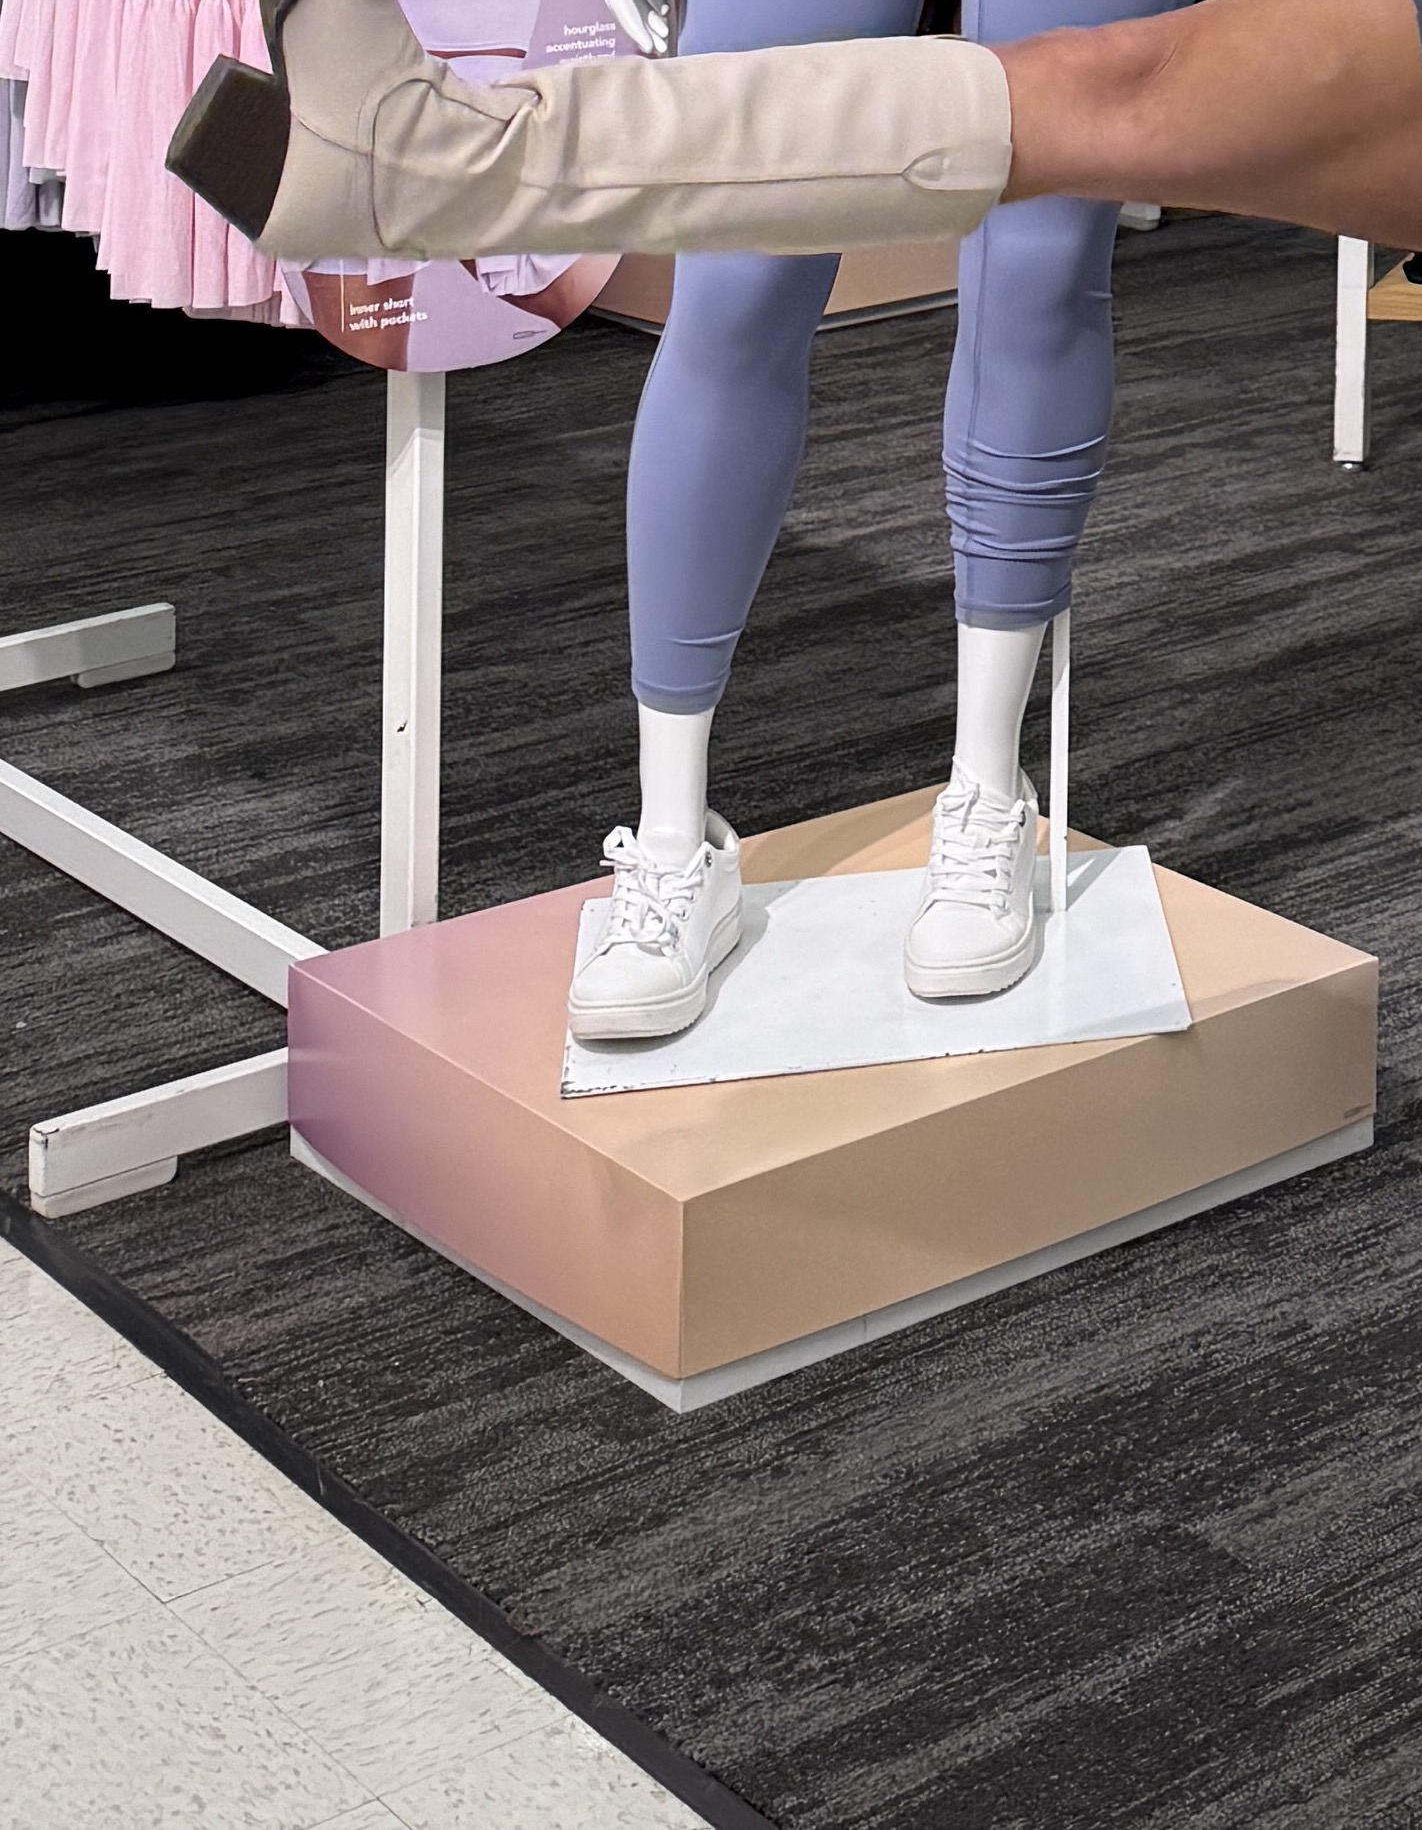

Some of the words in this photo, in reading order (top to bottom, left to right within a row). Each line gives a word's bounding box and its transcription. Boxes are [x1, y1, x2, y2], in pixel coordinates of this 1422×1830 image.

[563, 21, 617, 36] hourglass
[545, 36, 617, 53] accentuating
[349, 315, 379, 331] with
[380, 312, 428, 330] pockets
